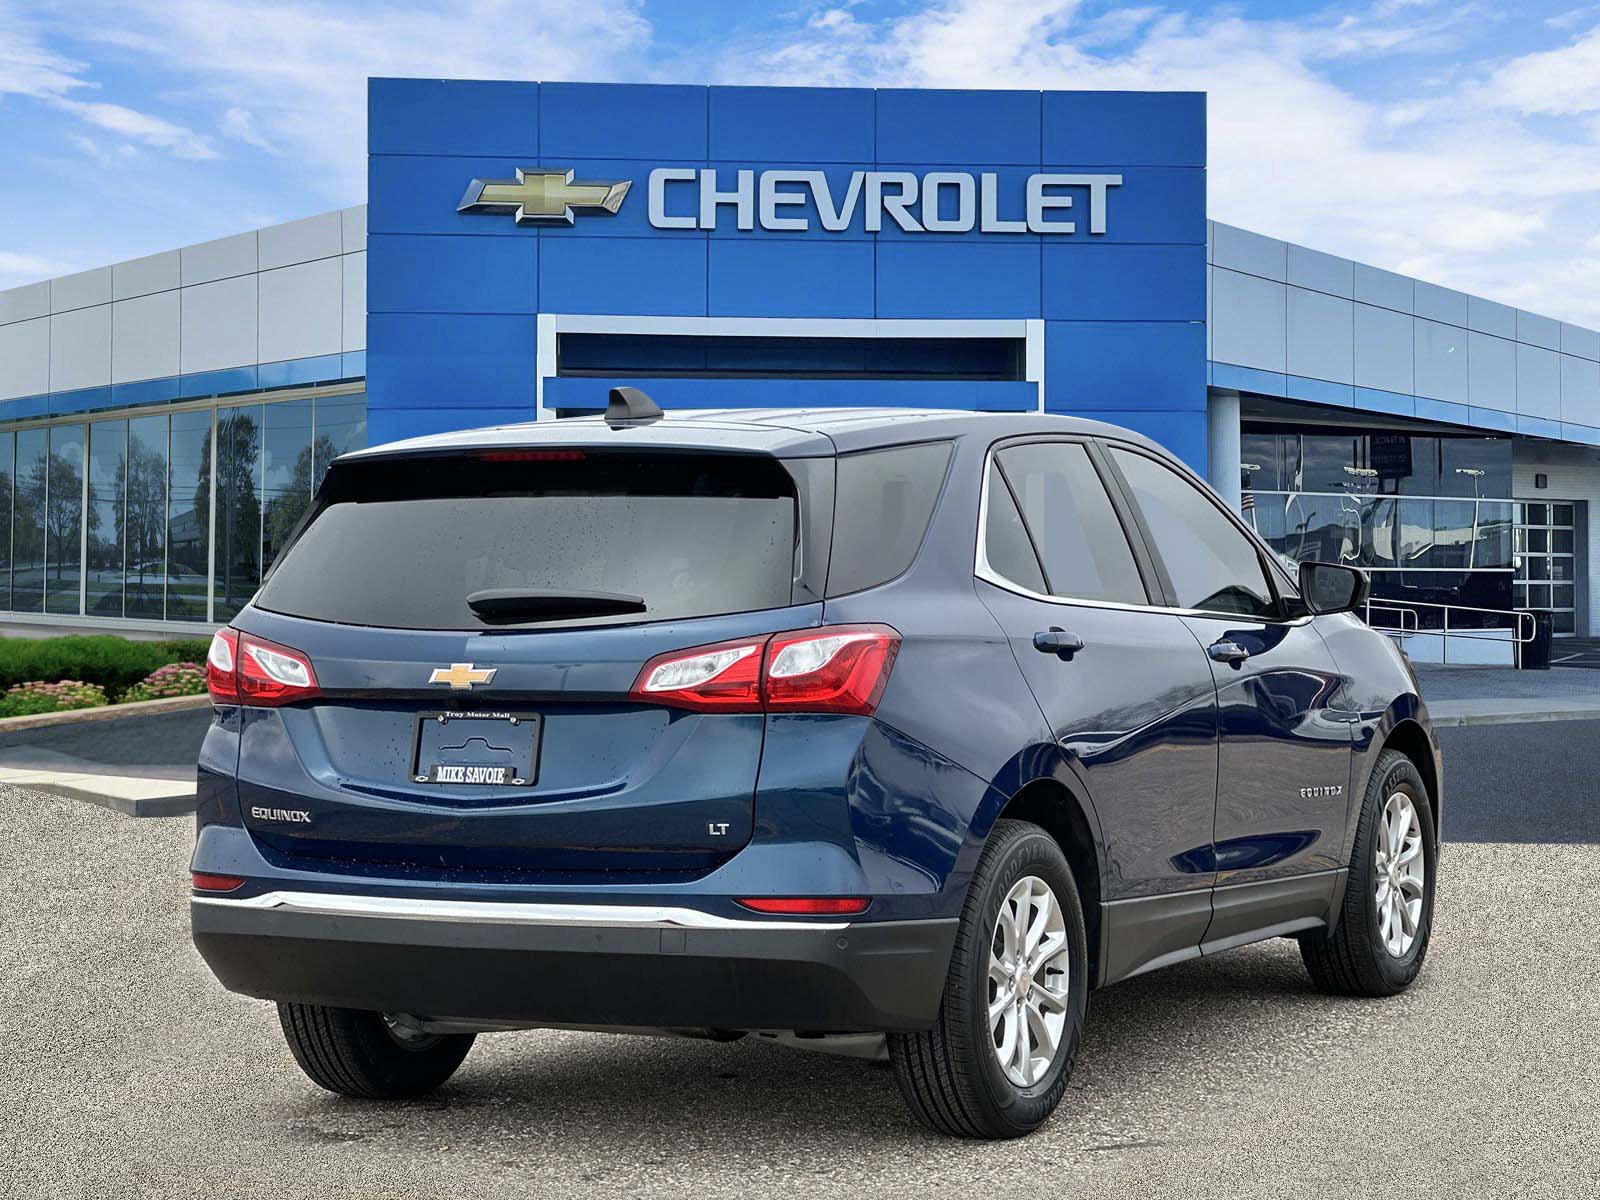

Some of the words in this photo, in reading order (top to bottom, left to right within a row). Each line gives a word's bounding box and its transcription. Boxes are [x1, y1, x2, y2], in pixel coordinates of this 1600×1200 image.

[648, 167, 1123, 235] CHEVROLET
[445, 711, 464, 719] Troy
[436, 766, 465, 783] MIKE
[465, 767, 505, 785] SAVOIE
[1300, 785, 1343, 798] EQUINOX
[251, 806, 312, 823] EQUINOX
[708, 823, 730, 836] LT
